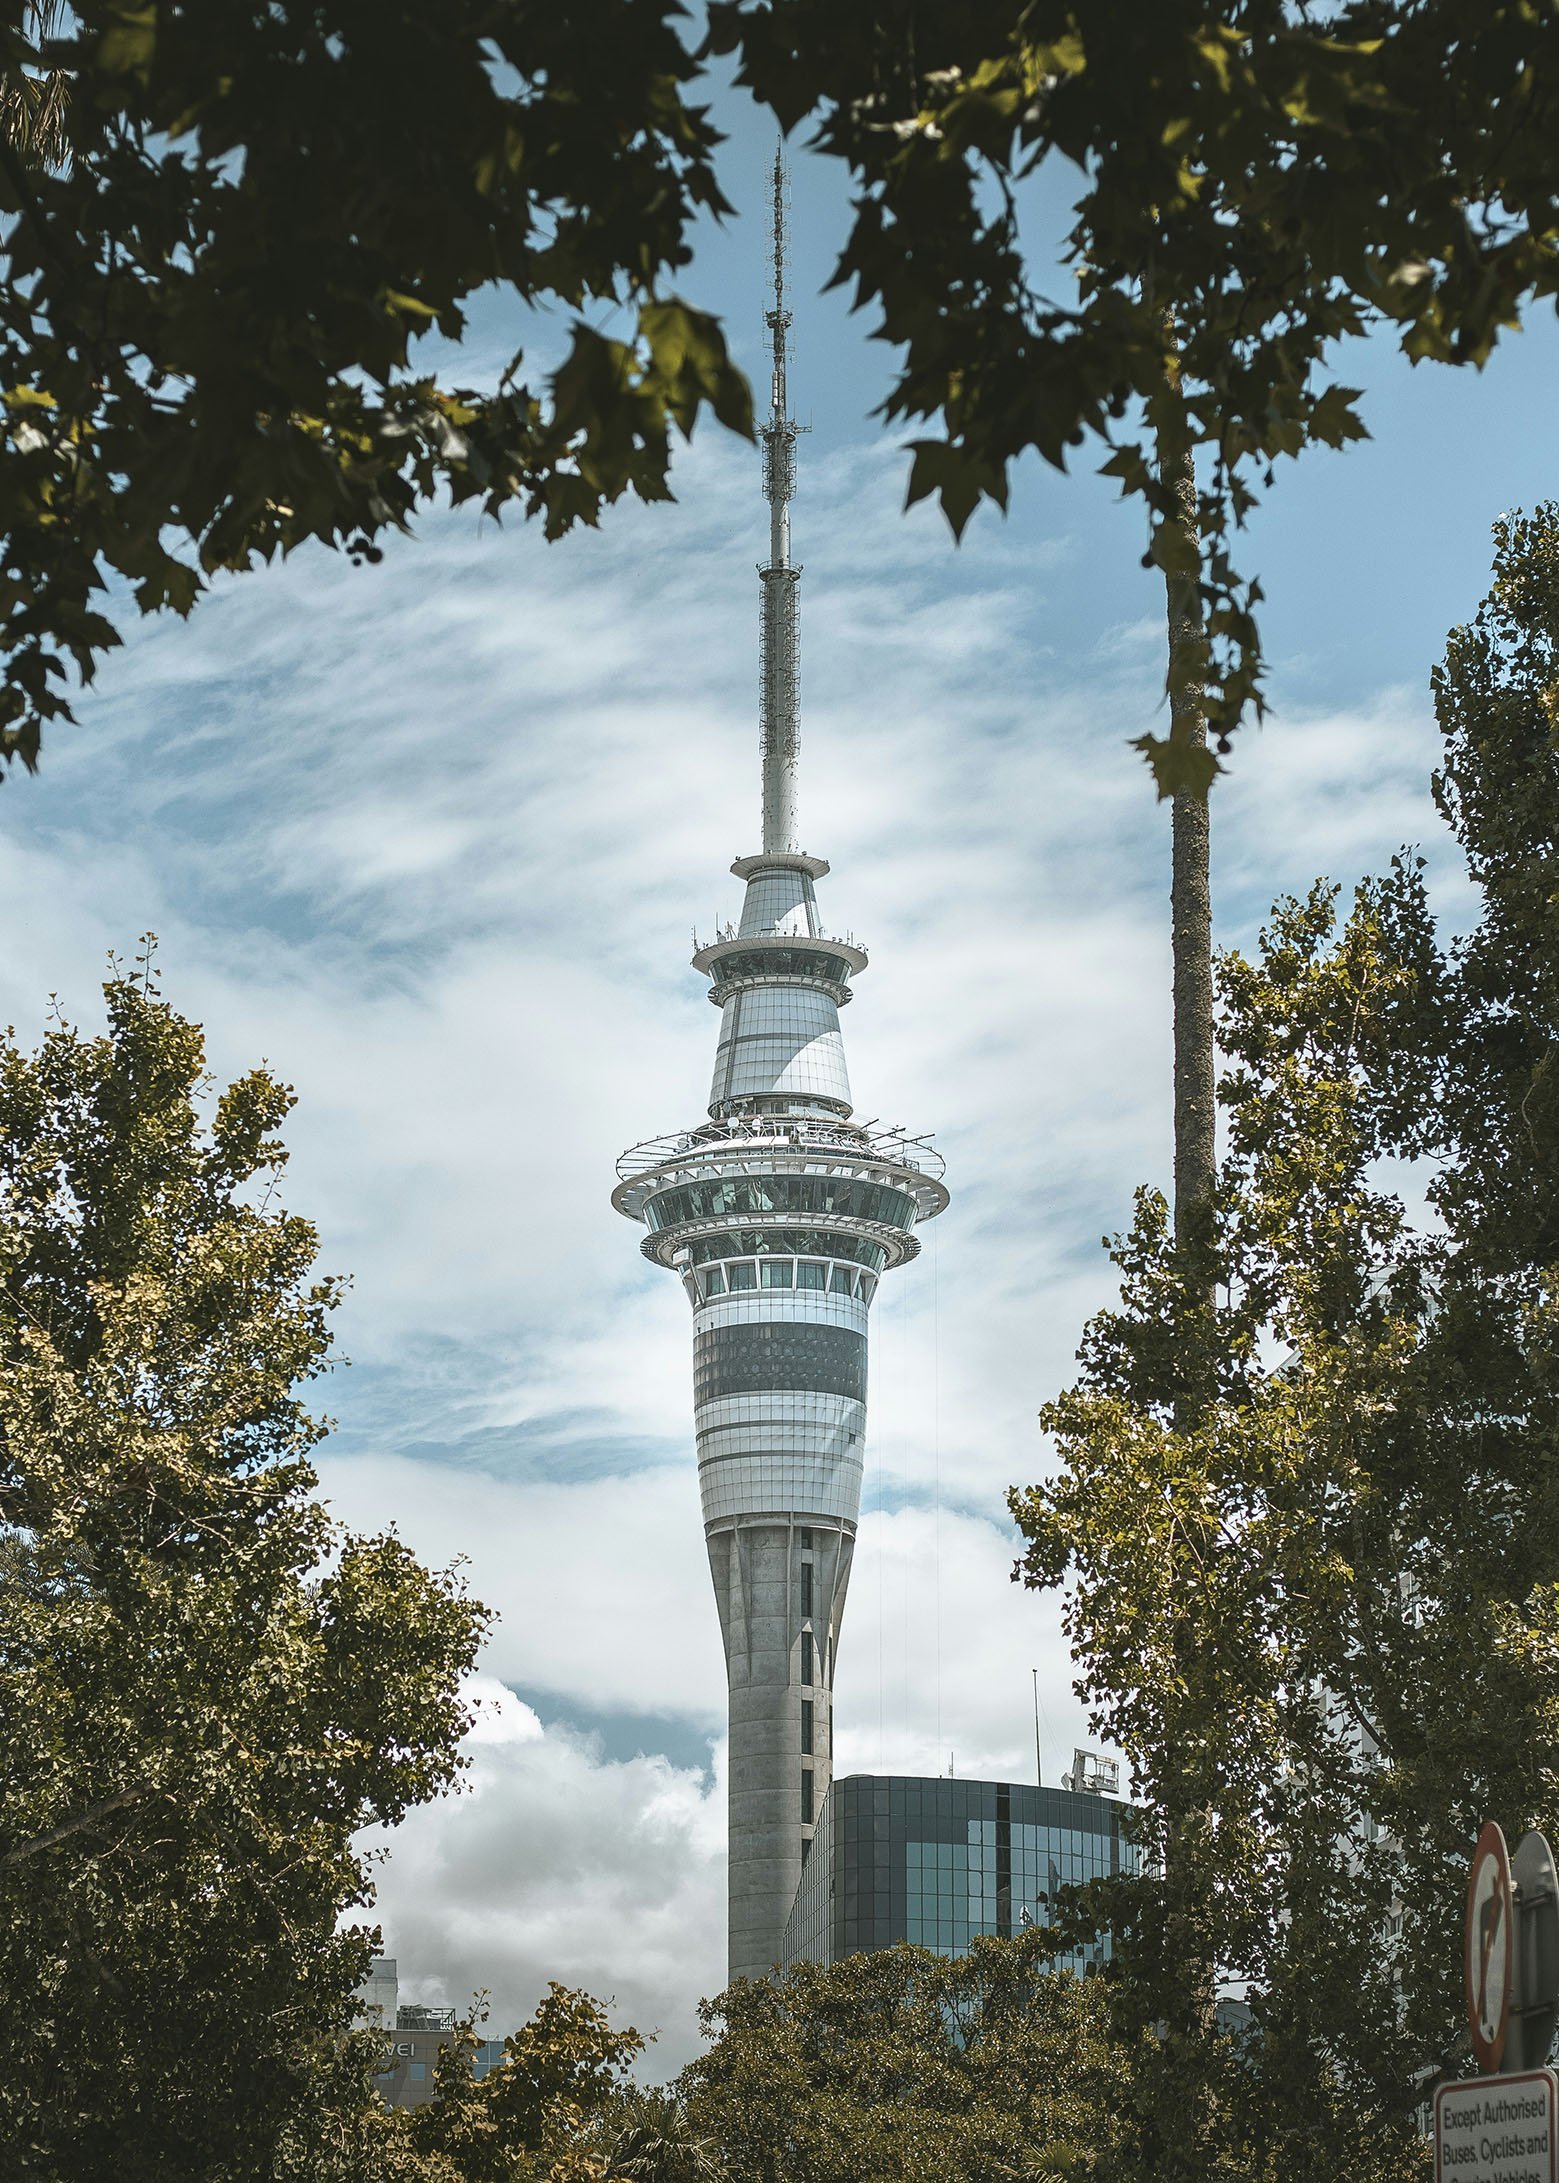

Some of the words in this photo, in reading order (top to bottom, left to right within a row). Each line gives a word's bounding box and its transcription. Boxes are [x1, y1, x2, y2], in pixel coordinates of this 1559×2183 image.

[1444, 2103, 1481, 2132] Except
[1484, 2094, 1546, 2125] Authorised
[1443, 2143, 1478, 2166] Buses,
[1481, 2134, 1525, 2165] Cyclists
[1527, 2130, 1548, 2155] and
[1494, 2169, 1541, 2183] Vhicles
